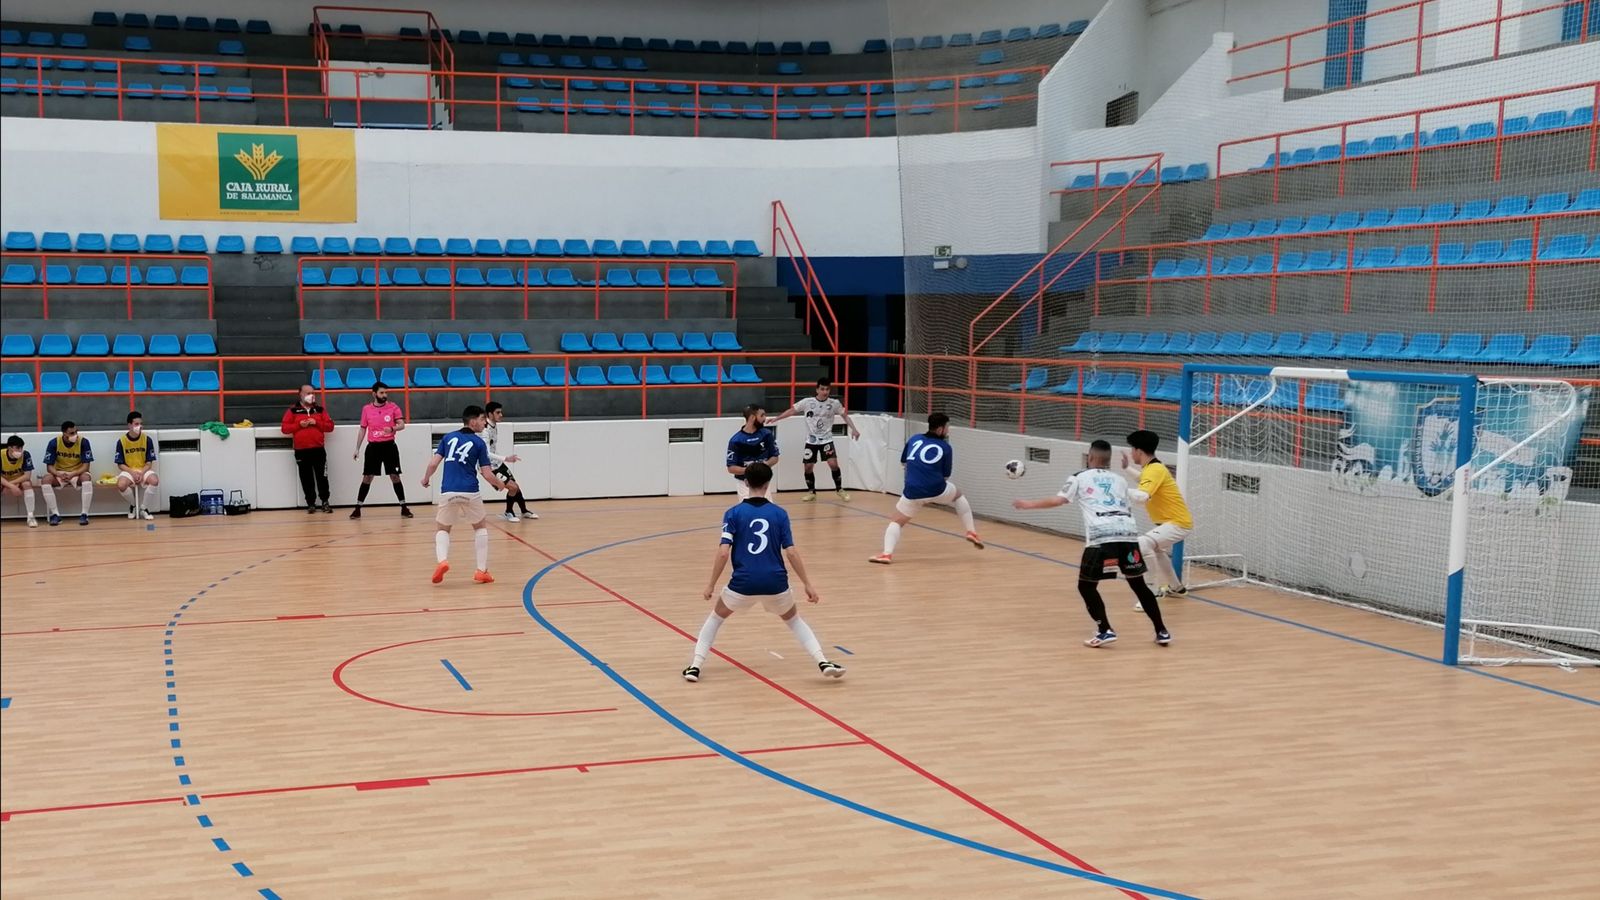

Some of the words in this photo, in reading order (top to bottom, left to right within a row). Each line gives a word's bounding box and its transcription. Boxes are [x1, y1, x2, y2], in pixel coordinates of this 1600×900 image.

[226, 182, 253, 192] CAJA
[255, 183, 292, 192] RURAL
[241, 192, 292, 200] SALAMANCA
[445, 437, 474, 464] 14
[906, 439, 944, 464] 10
[1098, 483, 1115, 506] 3
[747, 518, 770, 555] 3
